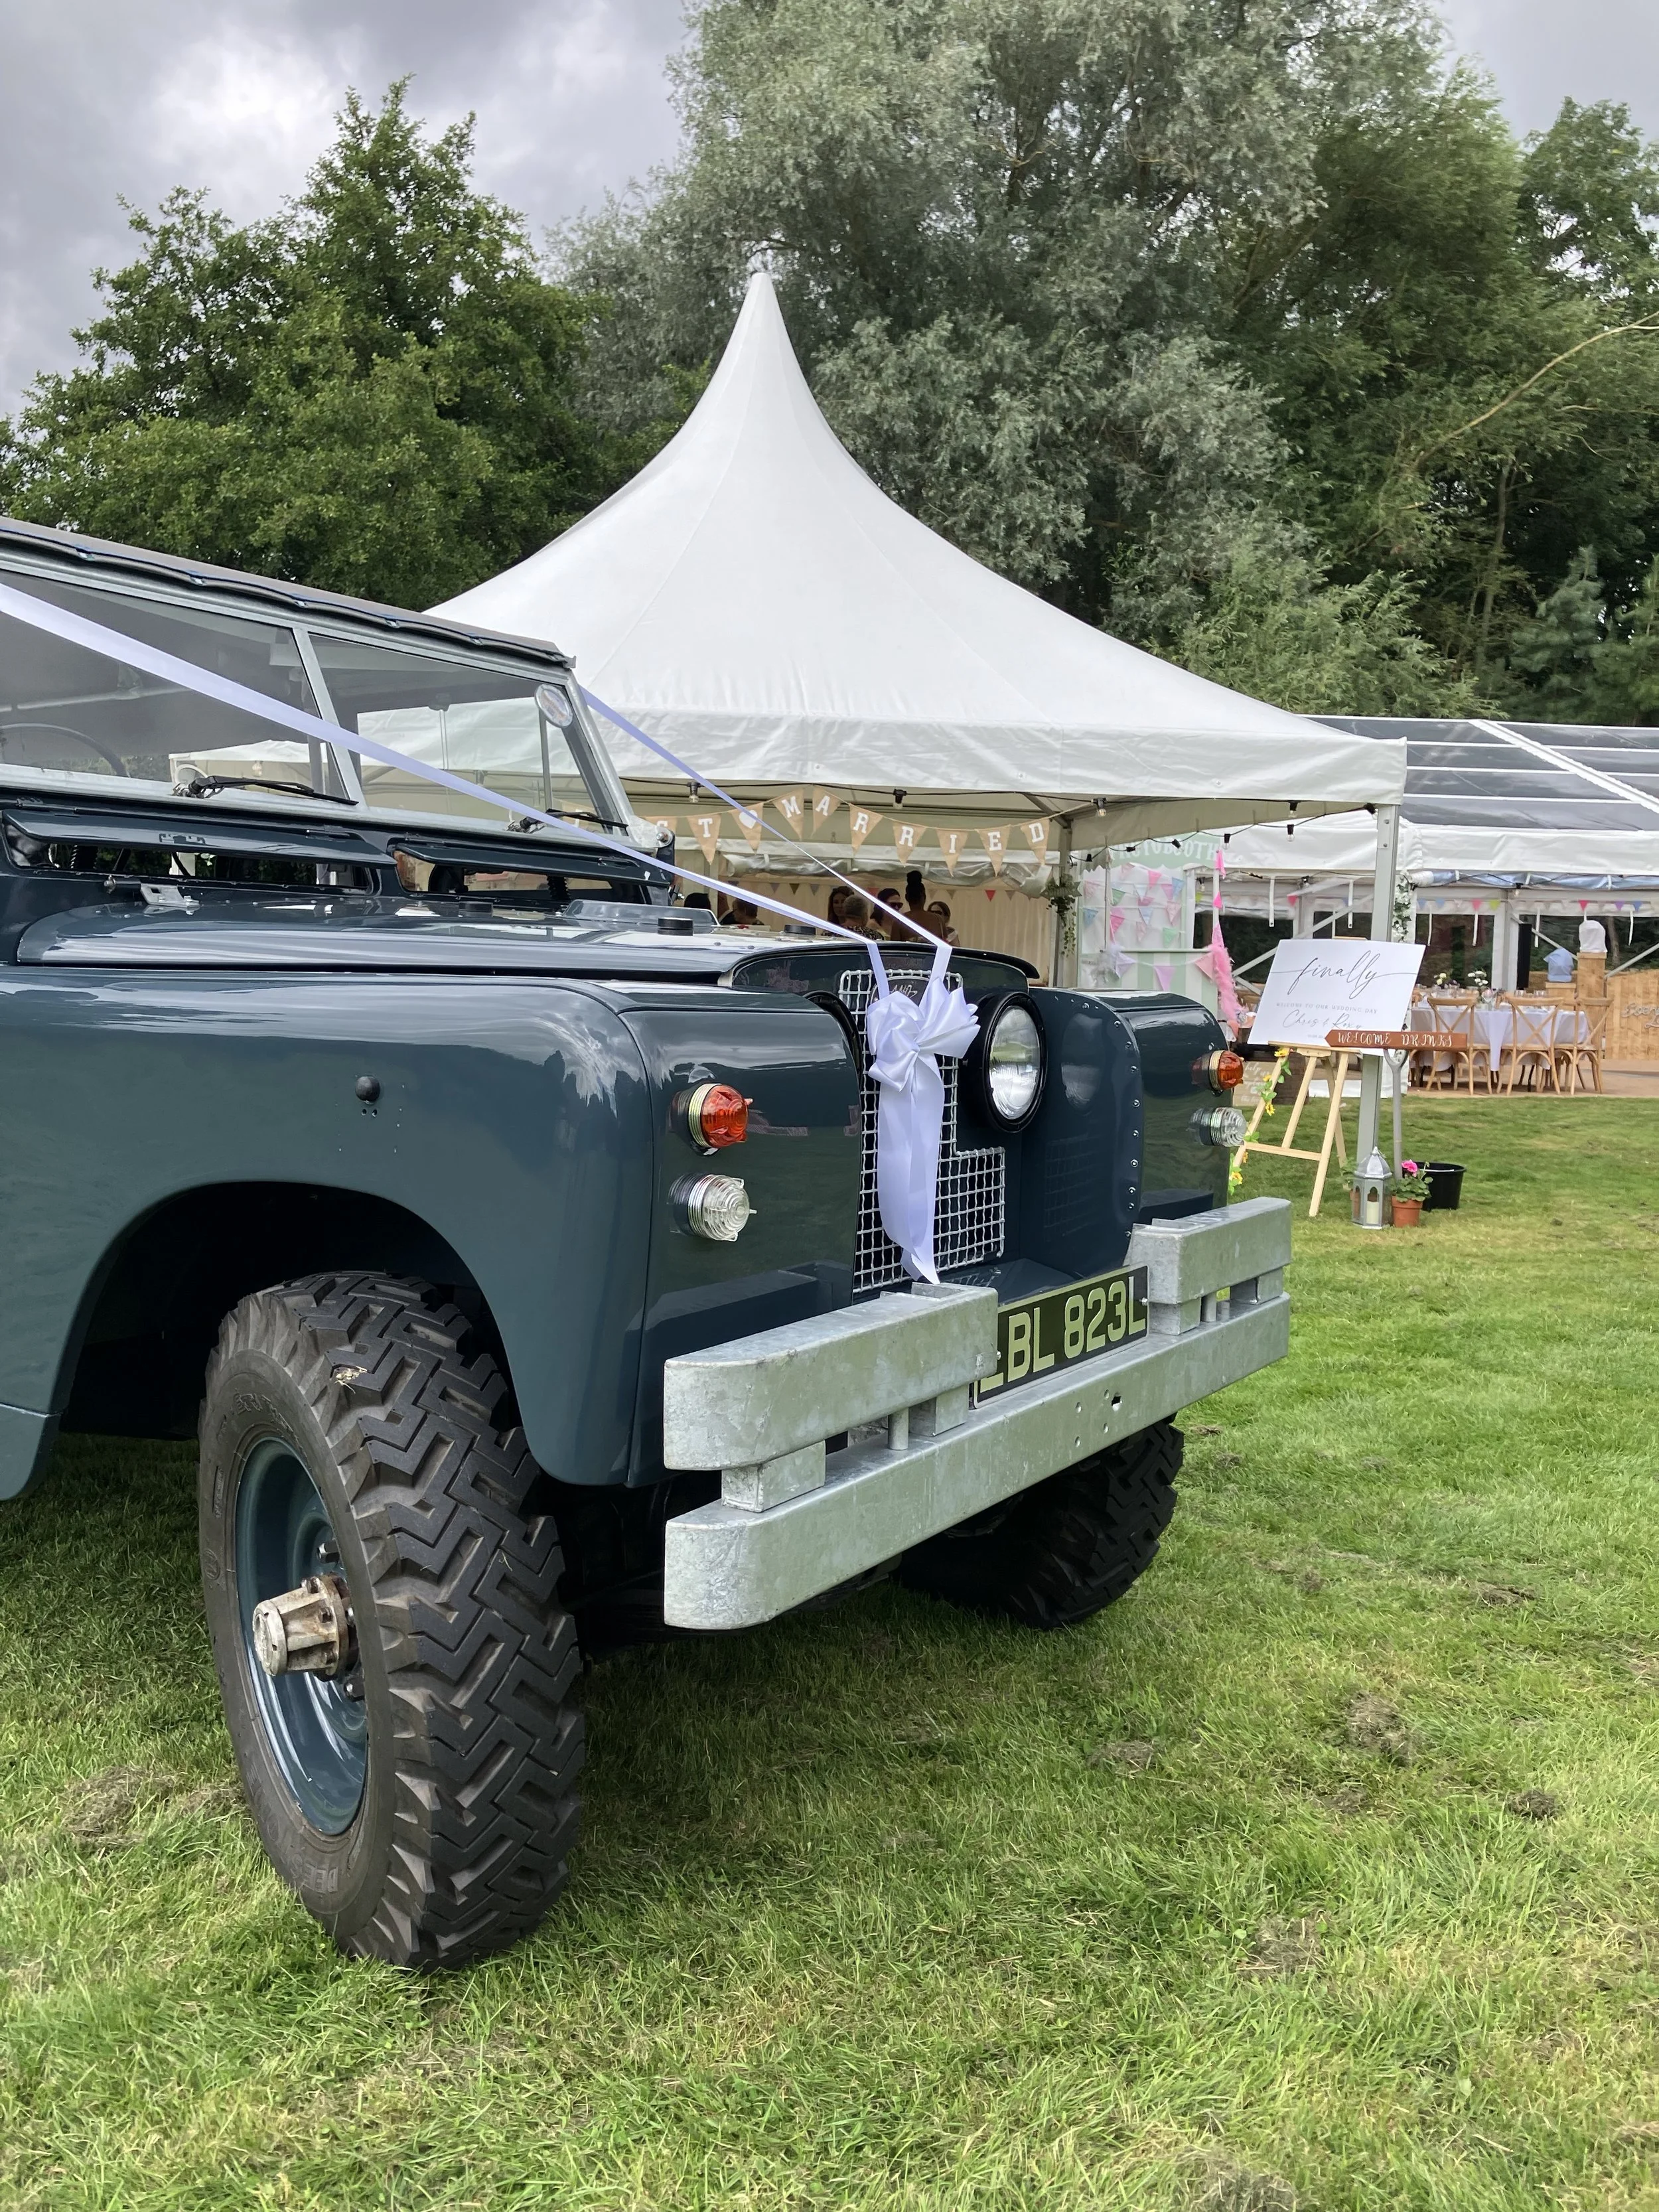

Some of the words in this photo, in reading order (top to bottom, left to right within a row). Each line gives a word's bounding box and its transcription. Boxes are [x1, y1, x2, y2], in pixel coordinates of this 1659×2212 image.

[785, 794, 1045, 854] MARRIED
[1271, 950, 1417, 999] finally
[1336, 1031, 1392, 1047] WELCOME
[1402, 1033, 1453, 1047] DRINKS
[980, 1307, 1054, 1393] BL
[1064, 1276, 1146, 1359] 823L
